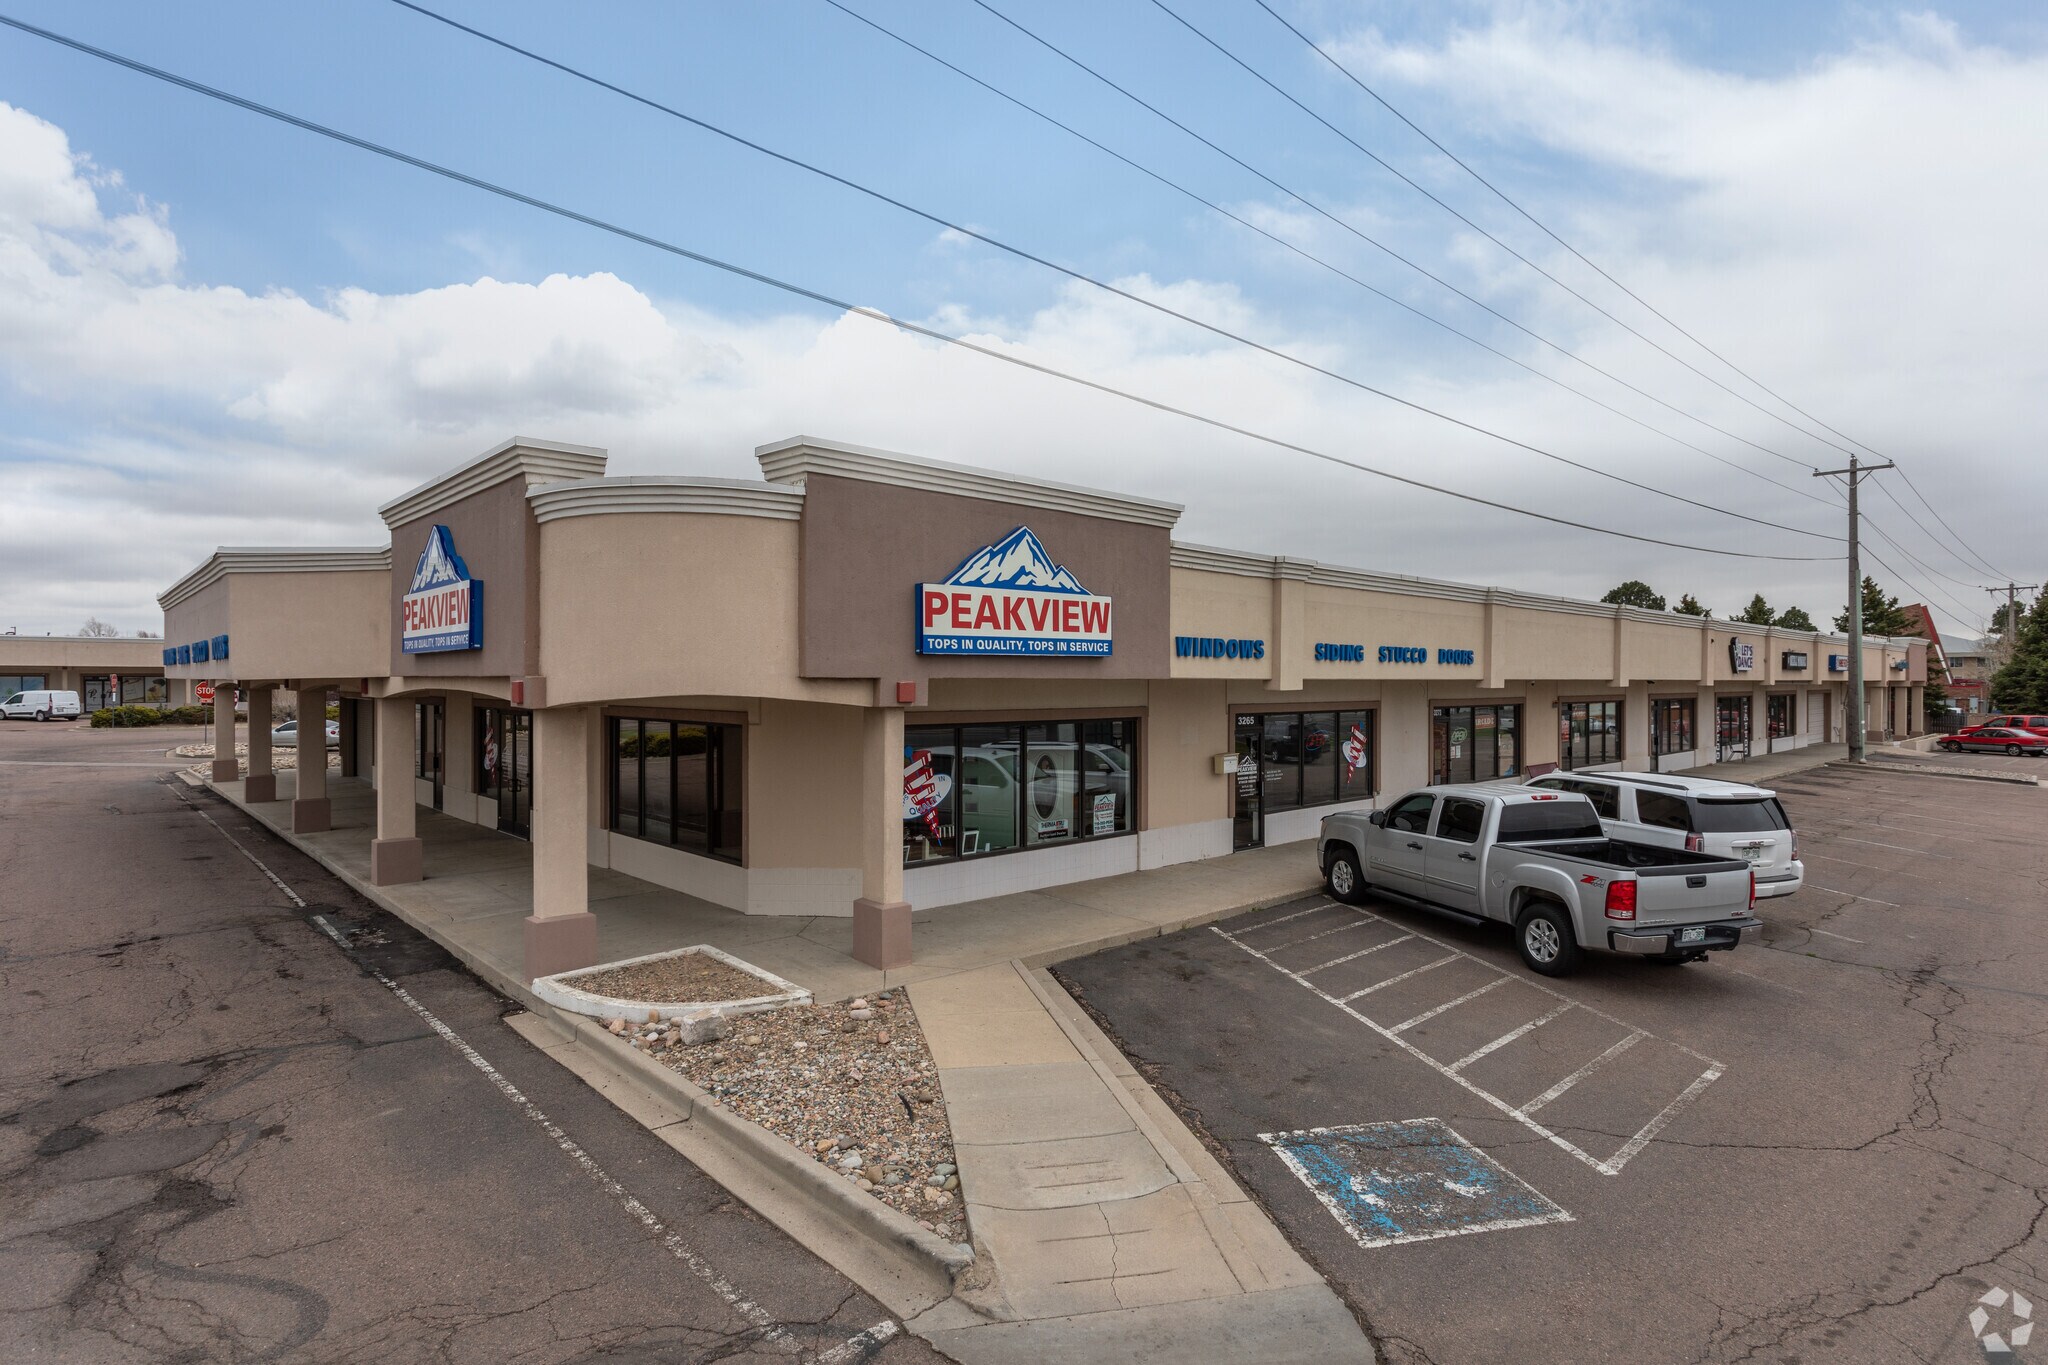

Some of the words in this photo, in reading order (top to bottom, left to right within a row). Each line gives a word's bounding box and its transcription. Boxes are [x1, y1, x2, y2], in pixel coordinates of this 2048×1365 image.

[403, 588, 470, 632] PEAKVIEW
[924, 591, 1110, 634] PEAKVIEW
[404, 641, 413, 650] TOPS
[435, 637, 445, 646] TOPS
[451, 634, 469, 645] SERVICE
[928, 638, 958, 650] TOPS
[962, 639, 974, 650] IN
[976, 640, 1025, 652] QUALITY,
[1028, 641, 1053, 651] TOPS
[1057, 642, 1067, 651] IN
[1070, 642, 1109, 652] SERVICE
[1175, 636, 1265, 659] WINDOWS
[1742, 645, 1752, 656] LET'S
[1314, 642, 1364, 662] SIDING
[1378, 645, 1427, 663] STUCCO
[1438, 648, 1474, 665] DOORS
[1738, 656, 1752, 668] DANCE
[1237, 716, 1254, 725] 3265
[909, 792, 942, 815] QUALITY
